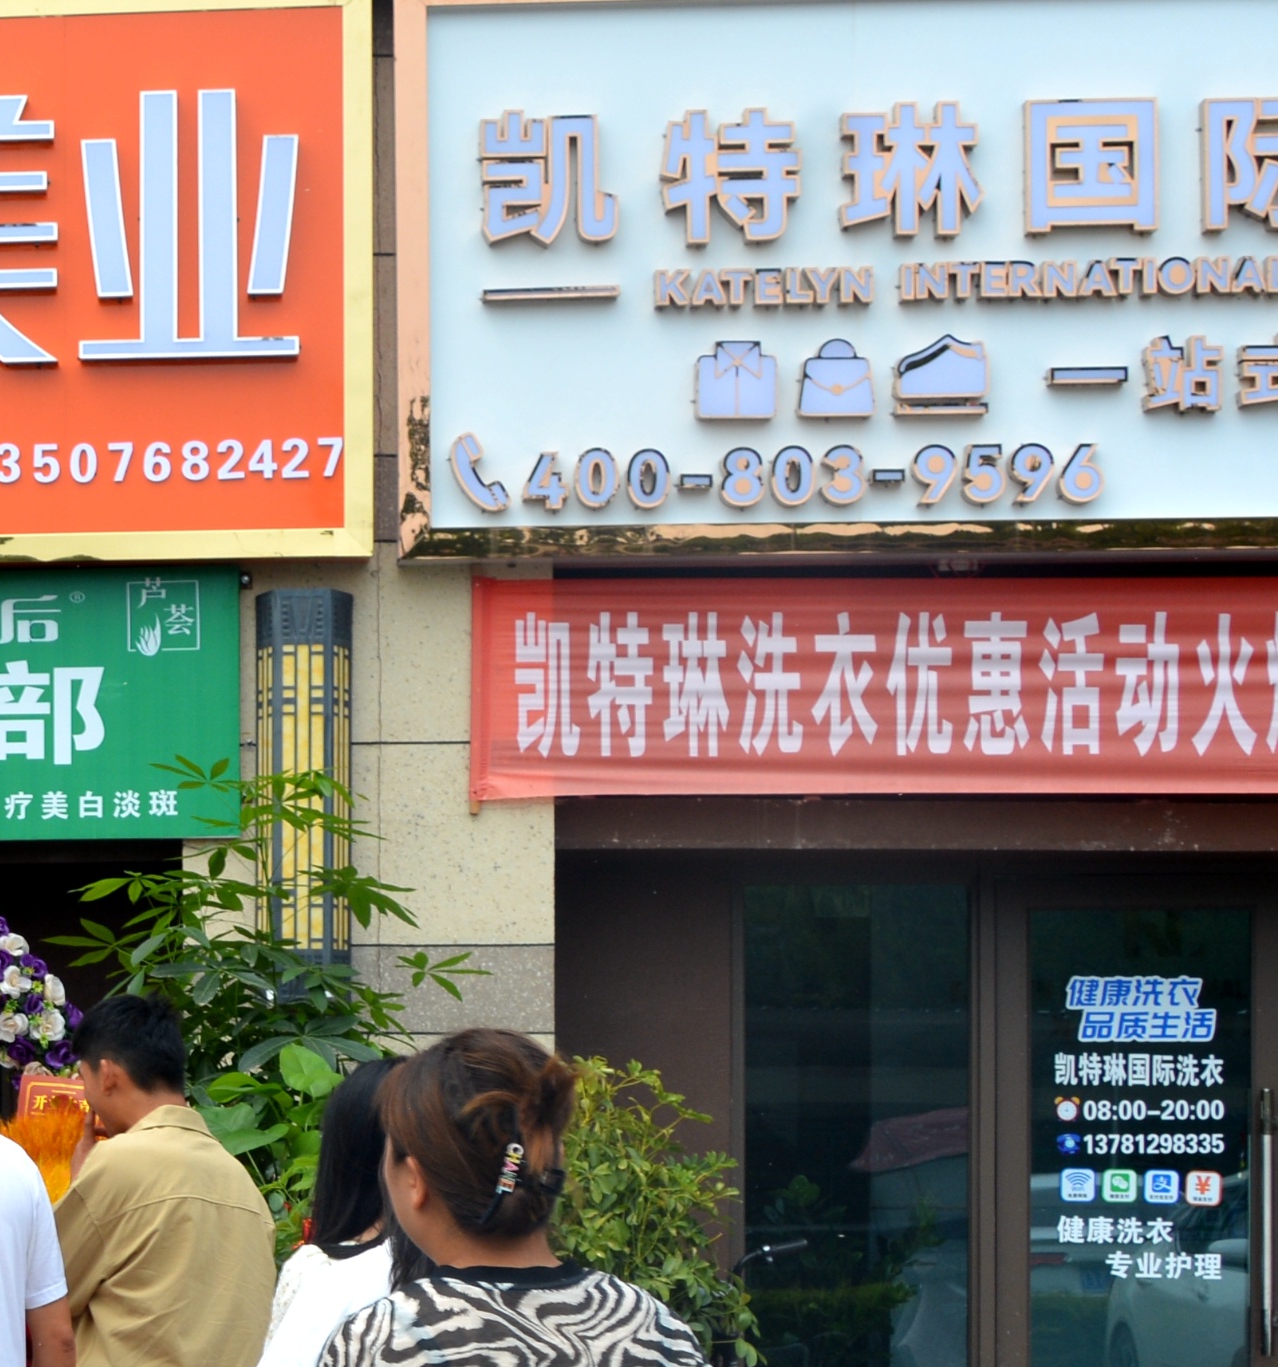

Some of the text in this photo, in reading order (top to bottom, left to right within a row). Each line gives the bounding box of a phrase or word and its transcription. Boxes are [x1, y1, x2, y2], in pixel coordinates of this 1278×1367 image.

[654, 266, 875, 310] KATELYN
[522, 442, 1105, 512] 400-803-9596
[514, 610, 1278, 757] 凯特琳洗衣优惠活动火
[1067, 978, 1201, 1008] 健康洗衣
[1080, 1011, 1216, 1040] 品质生活
[1054, 1053, 1224, 1087] 凯特琳国际洗衣
[1083, 1134, 1225, 1154] 13781298335
[1057, 1215, 1174, 1245] 健康洗衣
[1105, 1252, 1223, 1280] 专业护理
